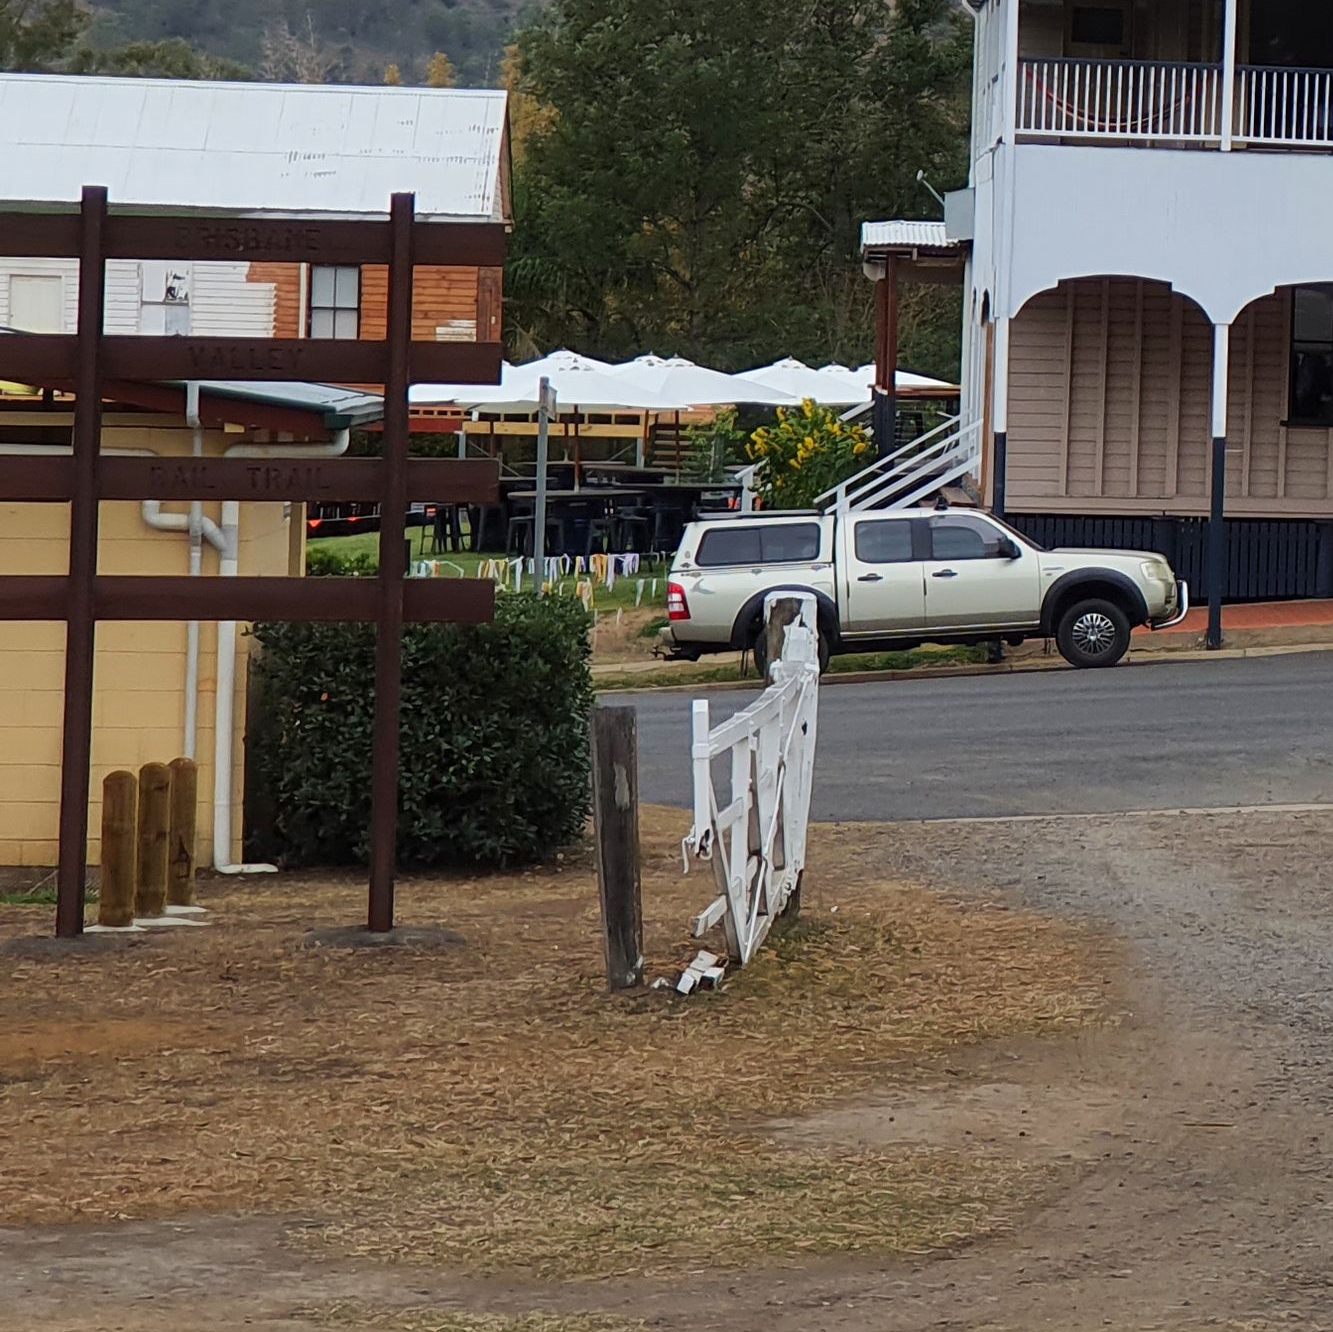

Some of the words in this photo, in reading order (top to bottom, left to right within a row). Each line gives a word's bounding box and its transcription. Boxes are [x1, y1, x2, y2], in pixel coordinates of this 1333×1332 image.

[174, 226, 321, 251] BRISBANE
[188, 347, 303, 370] VALLEY
[150, 466, 215, 490] RAIL
[246, 467, 330, 490] TRAIL
